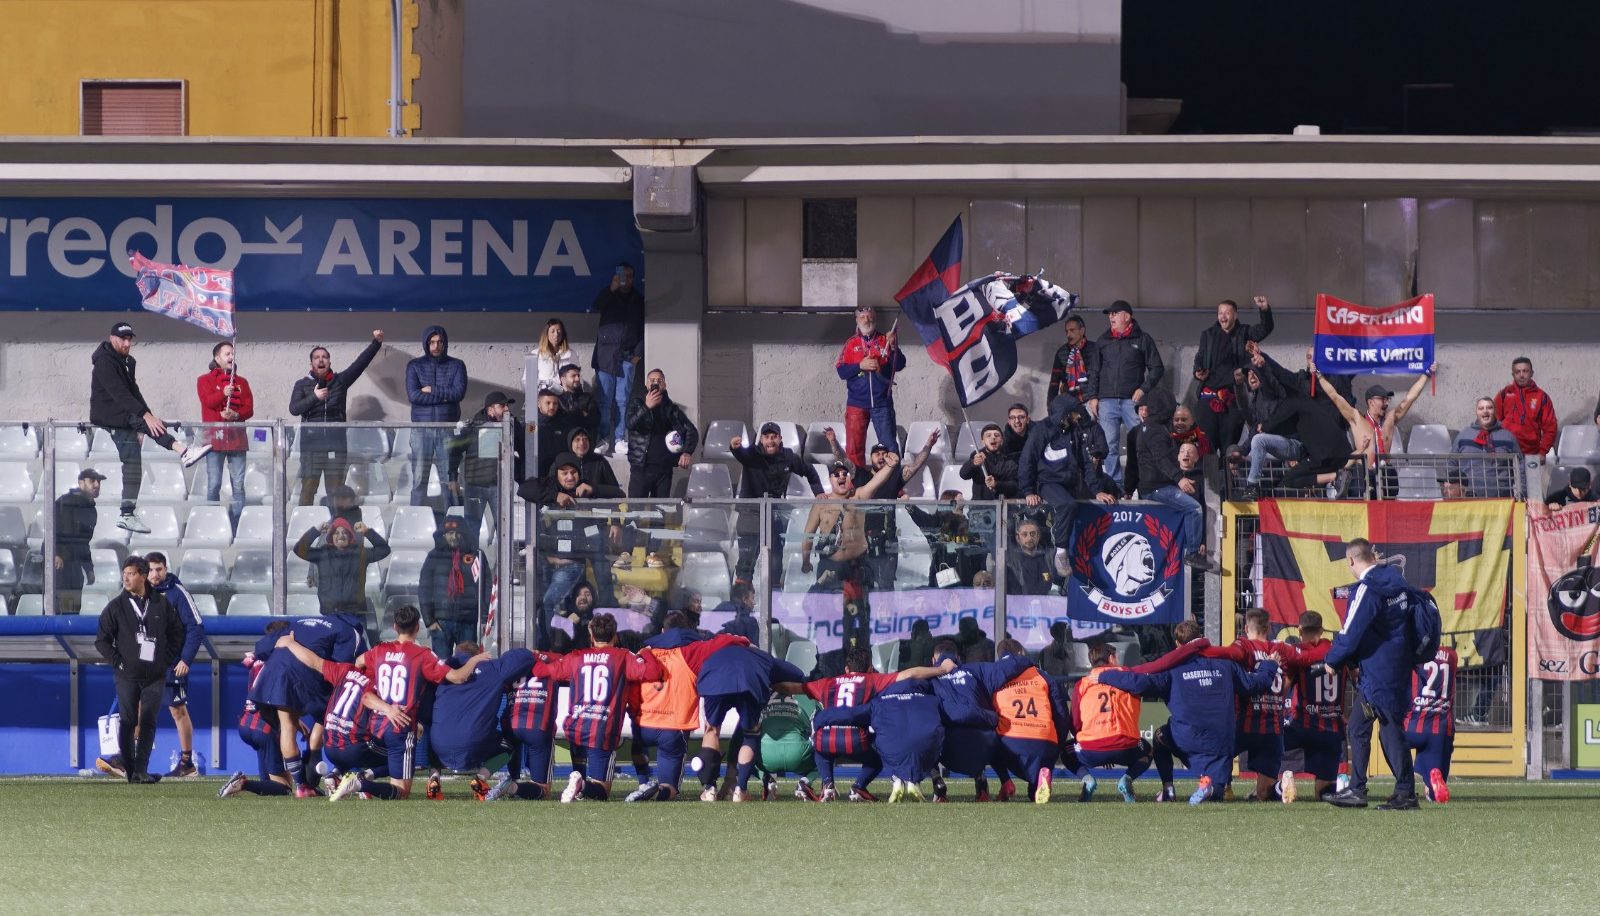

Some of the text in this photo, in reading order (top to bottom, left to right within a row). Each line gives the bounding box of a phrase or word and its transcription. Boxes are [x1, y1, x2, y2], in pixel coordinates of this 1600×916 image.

[315, 218, 592, 277] ARENA
[1326, 305, 1424, 326] CASERTANO
[1324, 347, 1424, 363] E ME NE VANTO
[1112, 511, 1143, 523] 2017
[1101, 602, 1149, 616] BOYS CE
[1539, 658, 1568, 673] sez.
[378, 663, 407, 703] 66
[581, 664, 609, 703] 16
[1315, 673, 1338, 702] 19
[1421, 660, 1450, 699] 21
[333, 681, 360, 718] 11
[1012, 697, 1039, 719] 24
[1306, 704, 1319, 713] GM
[1414, 697, 1429, 706] GM
[1585, 719, 1600, 744] L
